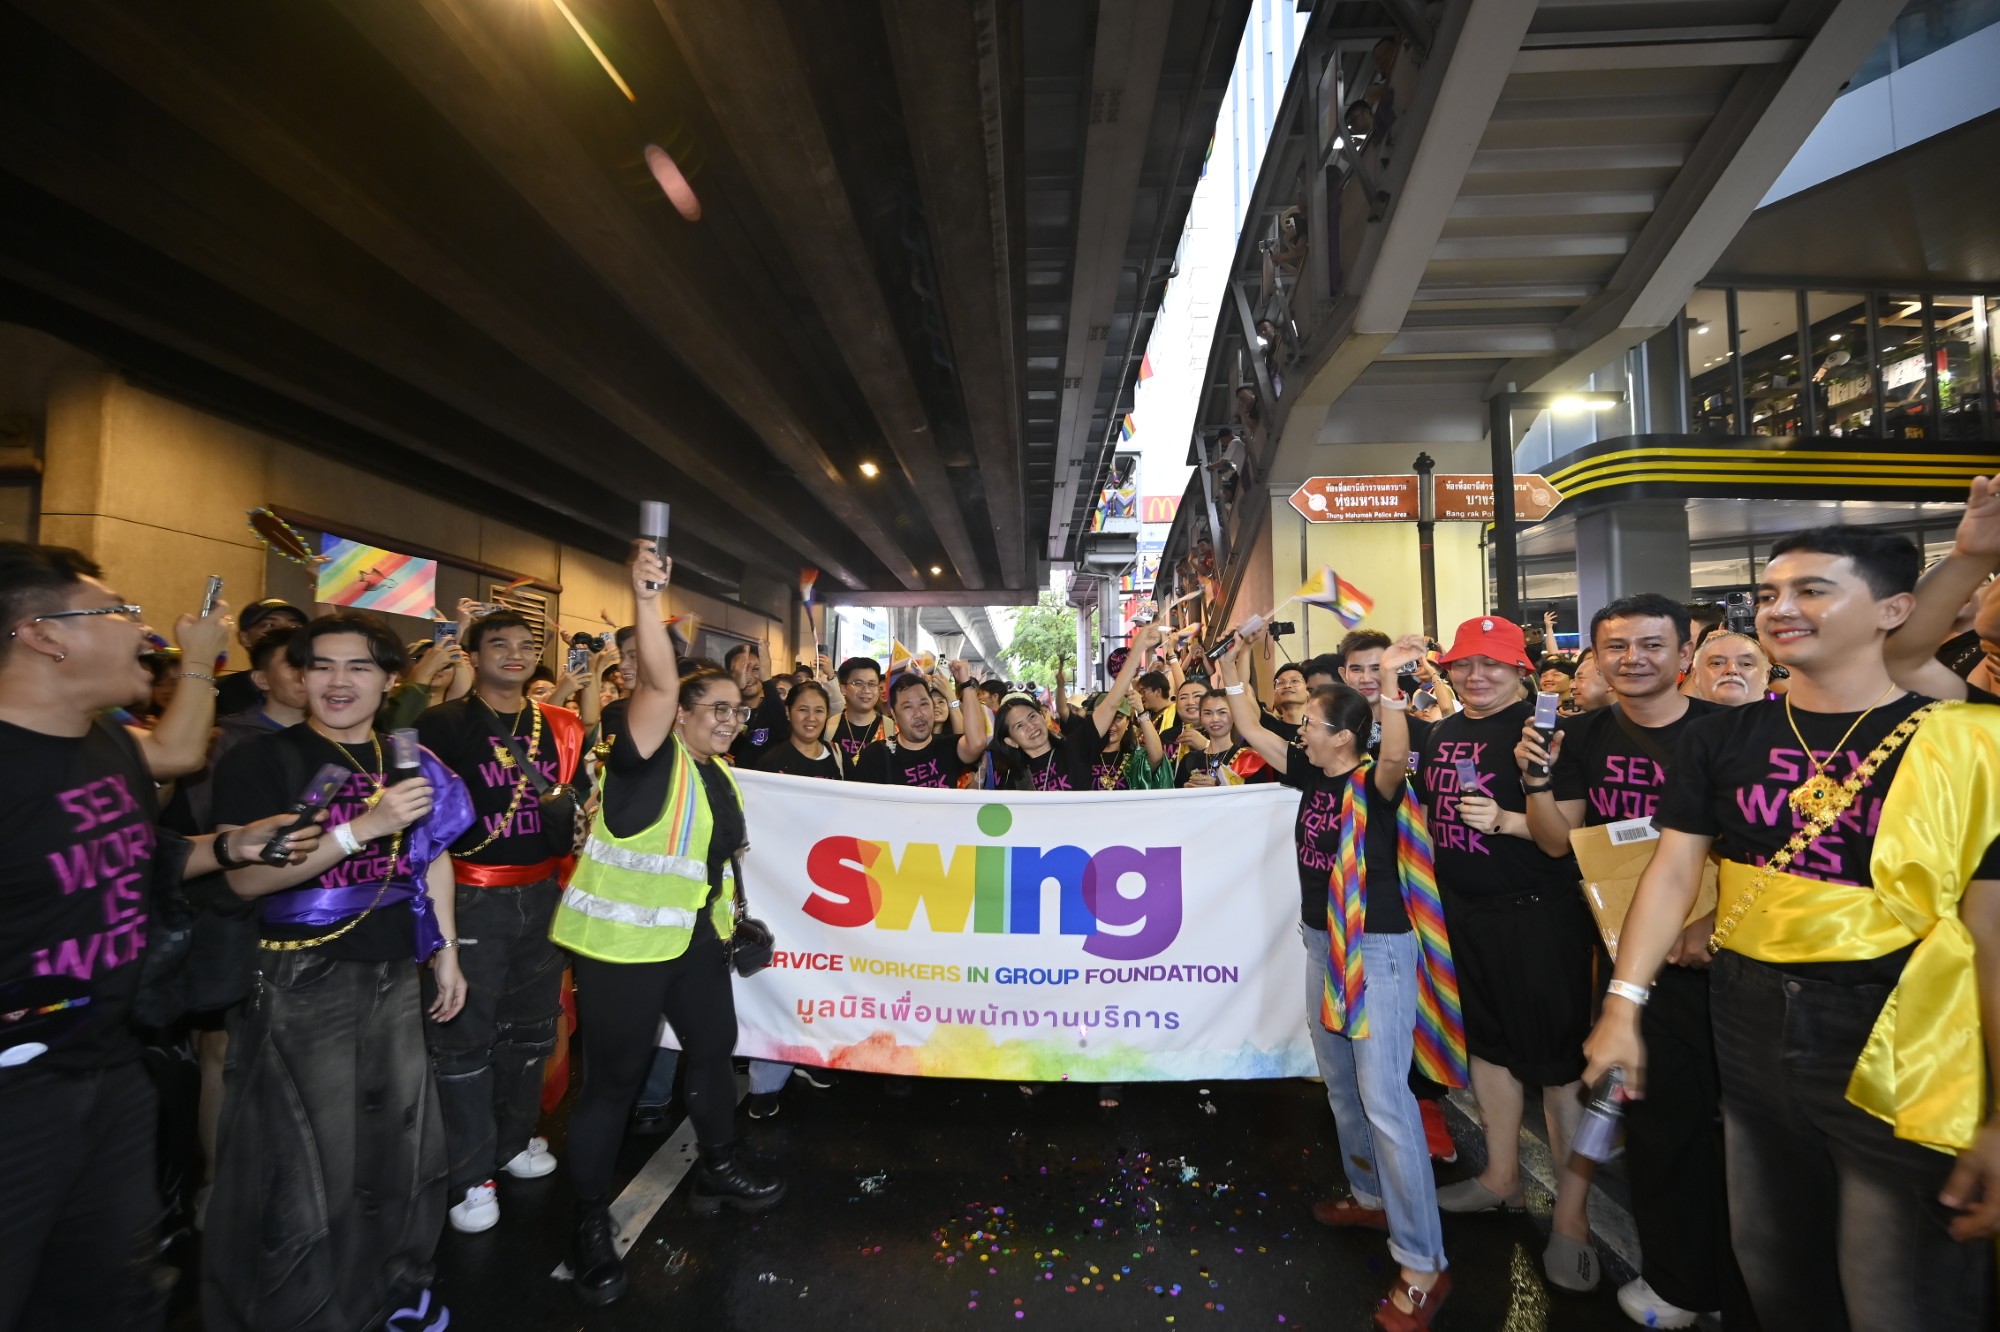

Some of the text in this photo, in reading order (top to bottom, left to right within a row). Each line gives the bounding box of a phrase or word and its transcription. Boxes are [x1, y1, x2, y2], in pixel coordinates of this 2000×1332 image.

[1446, 510, 1465, 518] Bang
[1433, 741, 1488, 765] SEX
[904, 758, 939, 783] SEX
[1603, 755, 1665, 786] SEX
[56, 774, 140, 832] SEX
[1435, 794, 1460, 821] IS
[48, 822, 157, 895] WOR
[801, 803, 1183, 961] swing
[760, 951, 1239, 985] RVICE WORKERS IN GROUP FOUNDATION
[796, 991, 1180, 1030] มูลนิธิเพื่อนพนักงานบริการ
